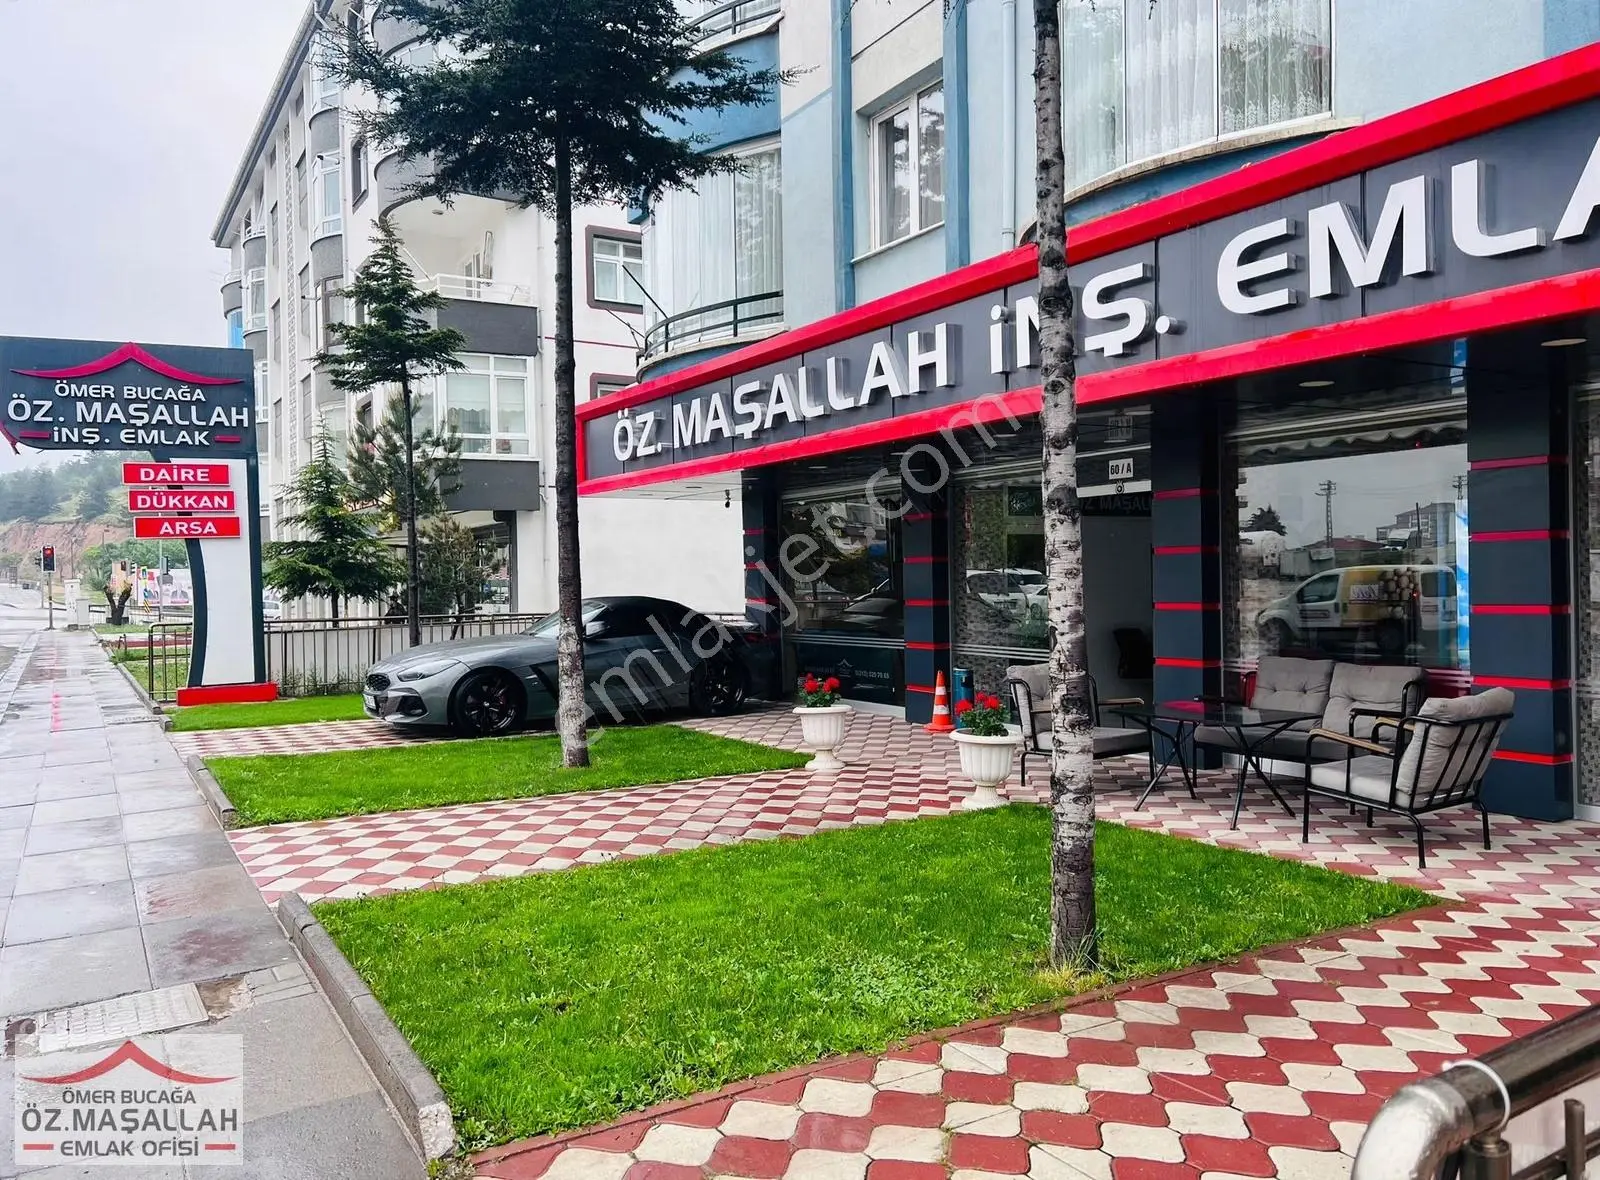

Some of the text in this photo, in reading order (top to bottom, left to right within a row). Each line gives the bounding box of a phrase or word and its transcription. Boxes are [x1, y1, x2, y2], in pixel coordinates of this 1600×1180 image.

[54, 379, 207, 402] ÖMER BUCAĞA
[613, 408, 662, 462] ÖZ.
[673, 322, 952, 449] MAŞALLAH
[7, 393, 249, 428] ÖZ. MAŞALLAH
[120, 428, 210, 446] EMLAK
[140, 464, 210, 482] DAİRE
[137, 490, 228, 509] DÜKKAN
[159, 521, 217, 535] ARSA
